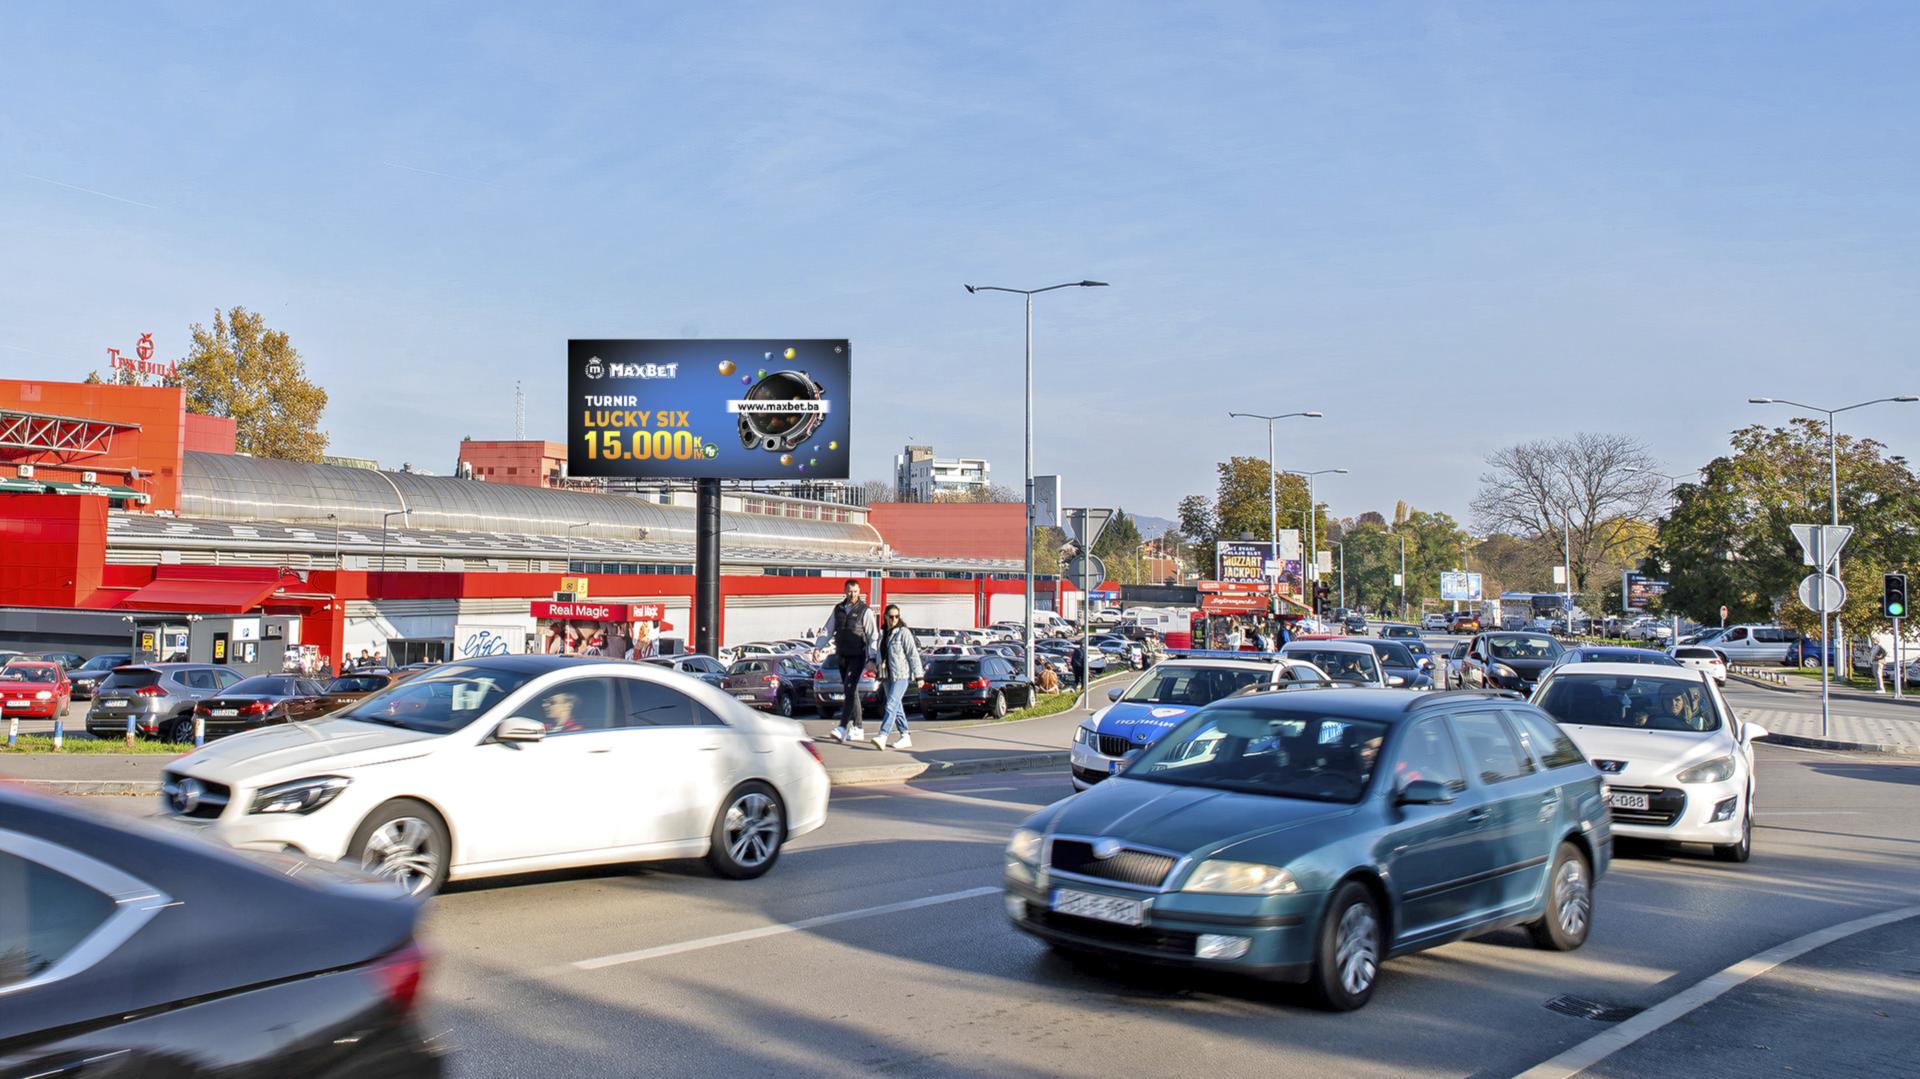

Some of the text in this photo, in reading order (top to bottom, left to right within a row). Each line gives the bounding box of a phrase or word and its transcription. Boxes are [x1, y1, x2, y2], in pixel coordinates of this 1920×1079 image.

[584, 395, 638, 407] TURNIR
[738, 402, 819, 411] www.maxbet.ba
[584, 410, 690, 427] LUCKY SIX
[584, 430, 693, 460] 15.000
[1223, 556, 1262, 567] MOZZART
[1223, 567, 1261, 577] JACKPOT
[549, 604, 609, 618] Real Magic
[633, 606, 659, 618] Real Magic
[1115, 719, 1177, 728] ПОЛИЦИ
